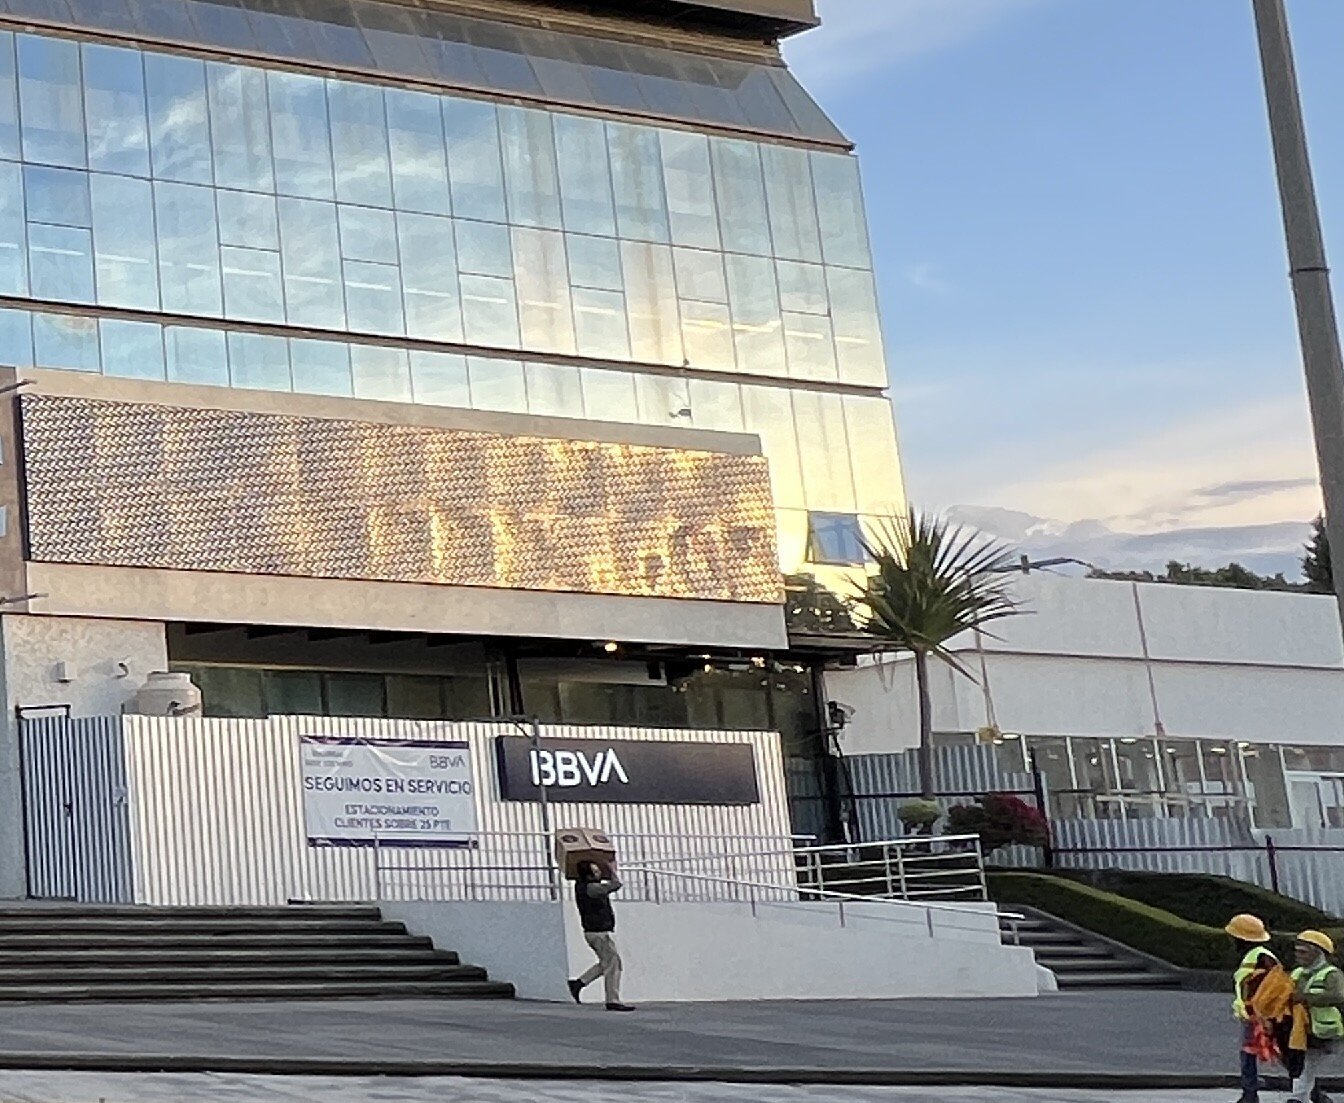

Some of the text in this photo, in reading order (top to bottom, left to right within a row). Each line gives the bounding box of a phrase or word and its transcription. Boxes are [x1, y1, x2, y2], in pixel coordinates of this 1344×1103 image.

[429, 755, 466, 769] BBVA
[530, 748, 629, 786] BBVA
[305, 777, 472, 795] SEGUIMOS EN SERVICIO
[345, 804, 440, 817] ESTACIONAMIENTO
[334, 818, 382, 829] CLIENTES
